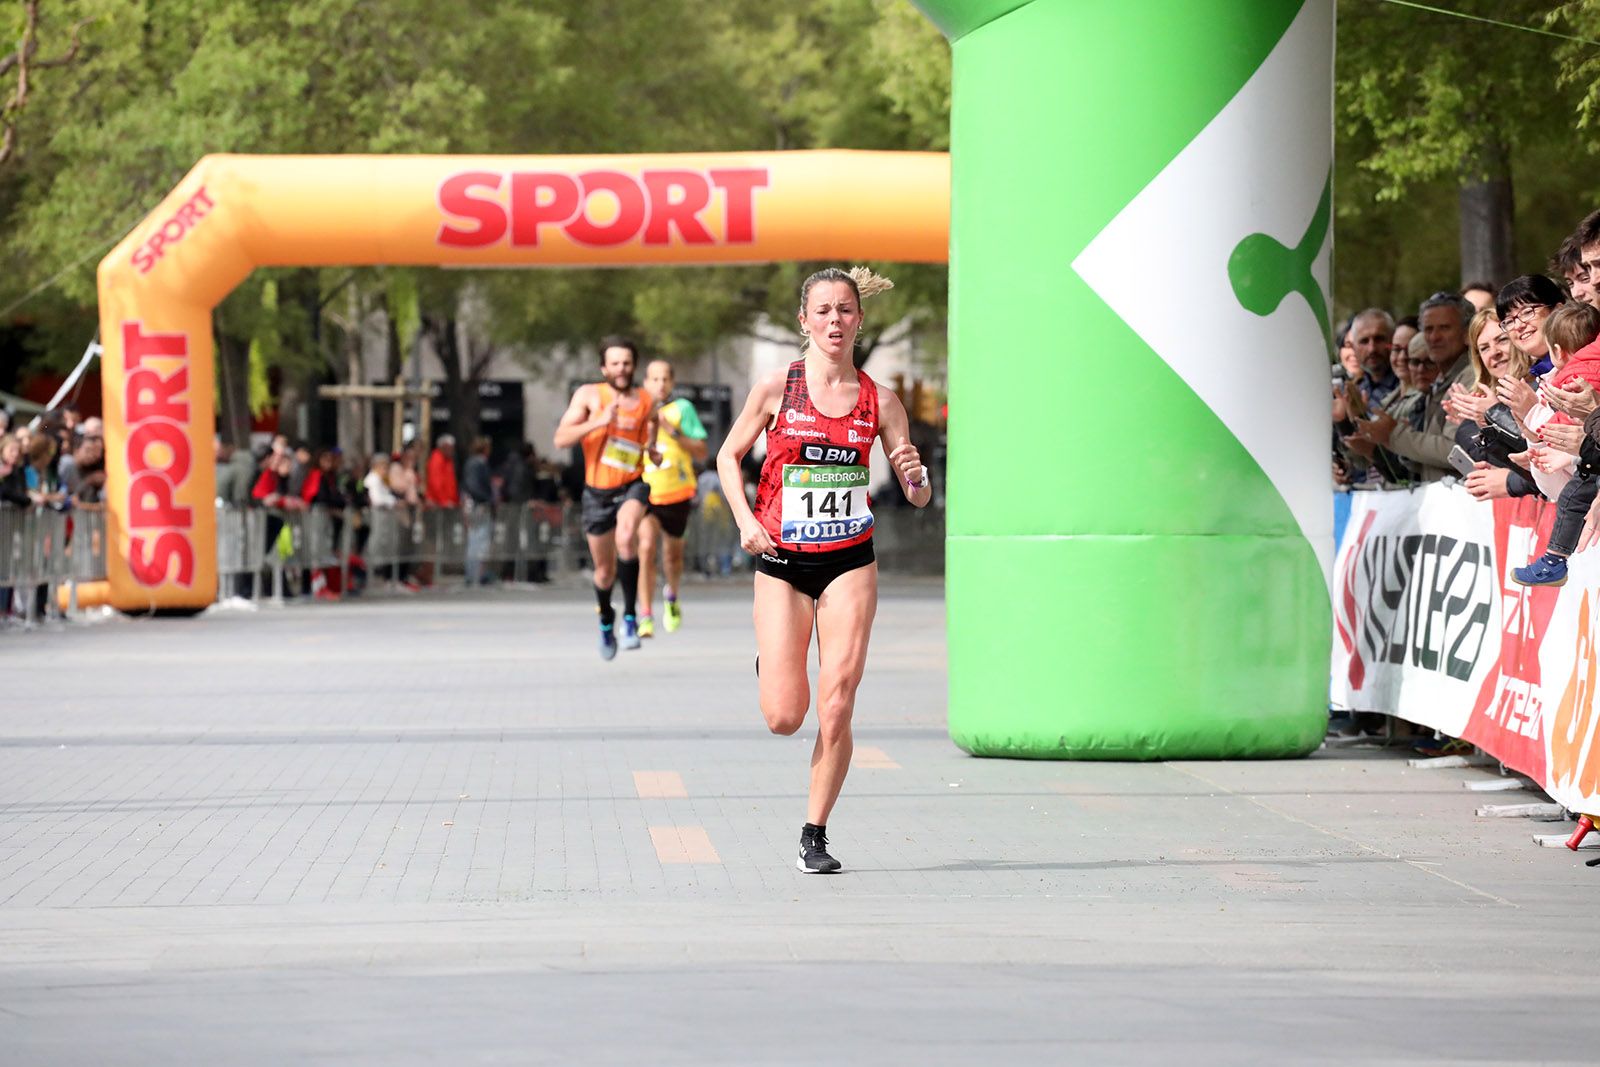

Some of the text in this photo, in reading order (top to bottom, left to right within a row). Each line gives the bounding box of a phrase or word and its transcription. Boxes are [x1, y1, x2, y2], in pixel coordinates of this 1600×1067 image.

[131, 186, 215, 274] SPORT
[437, 168, 769, 248] SPORT
[122, 322, 195, 590] SPORT
[811, 471, 866, 483] IBERDROLA
[824, 448, 857, 464] BM
[800, 490, 852, 518] 141
